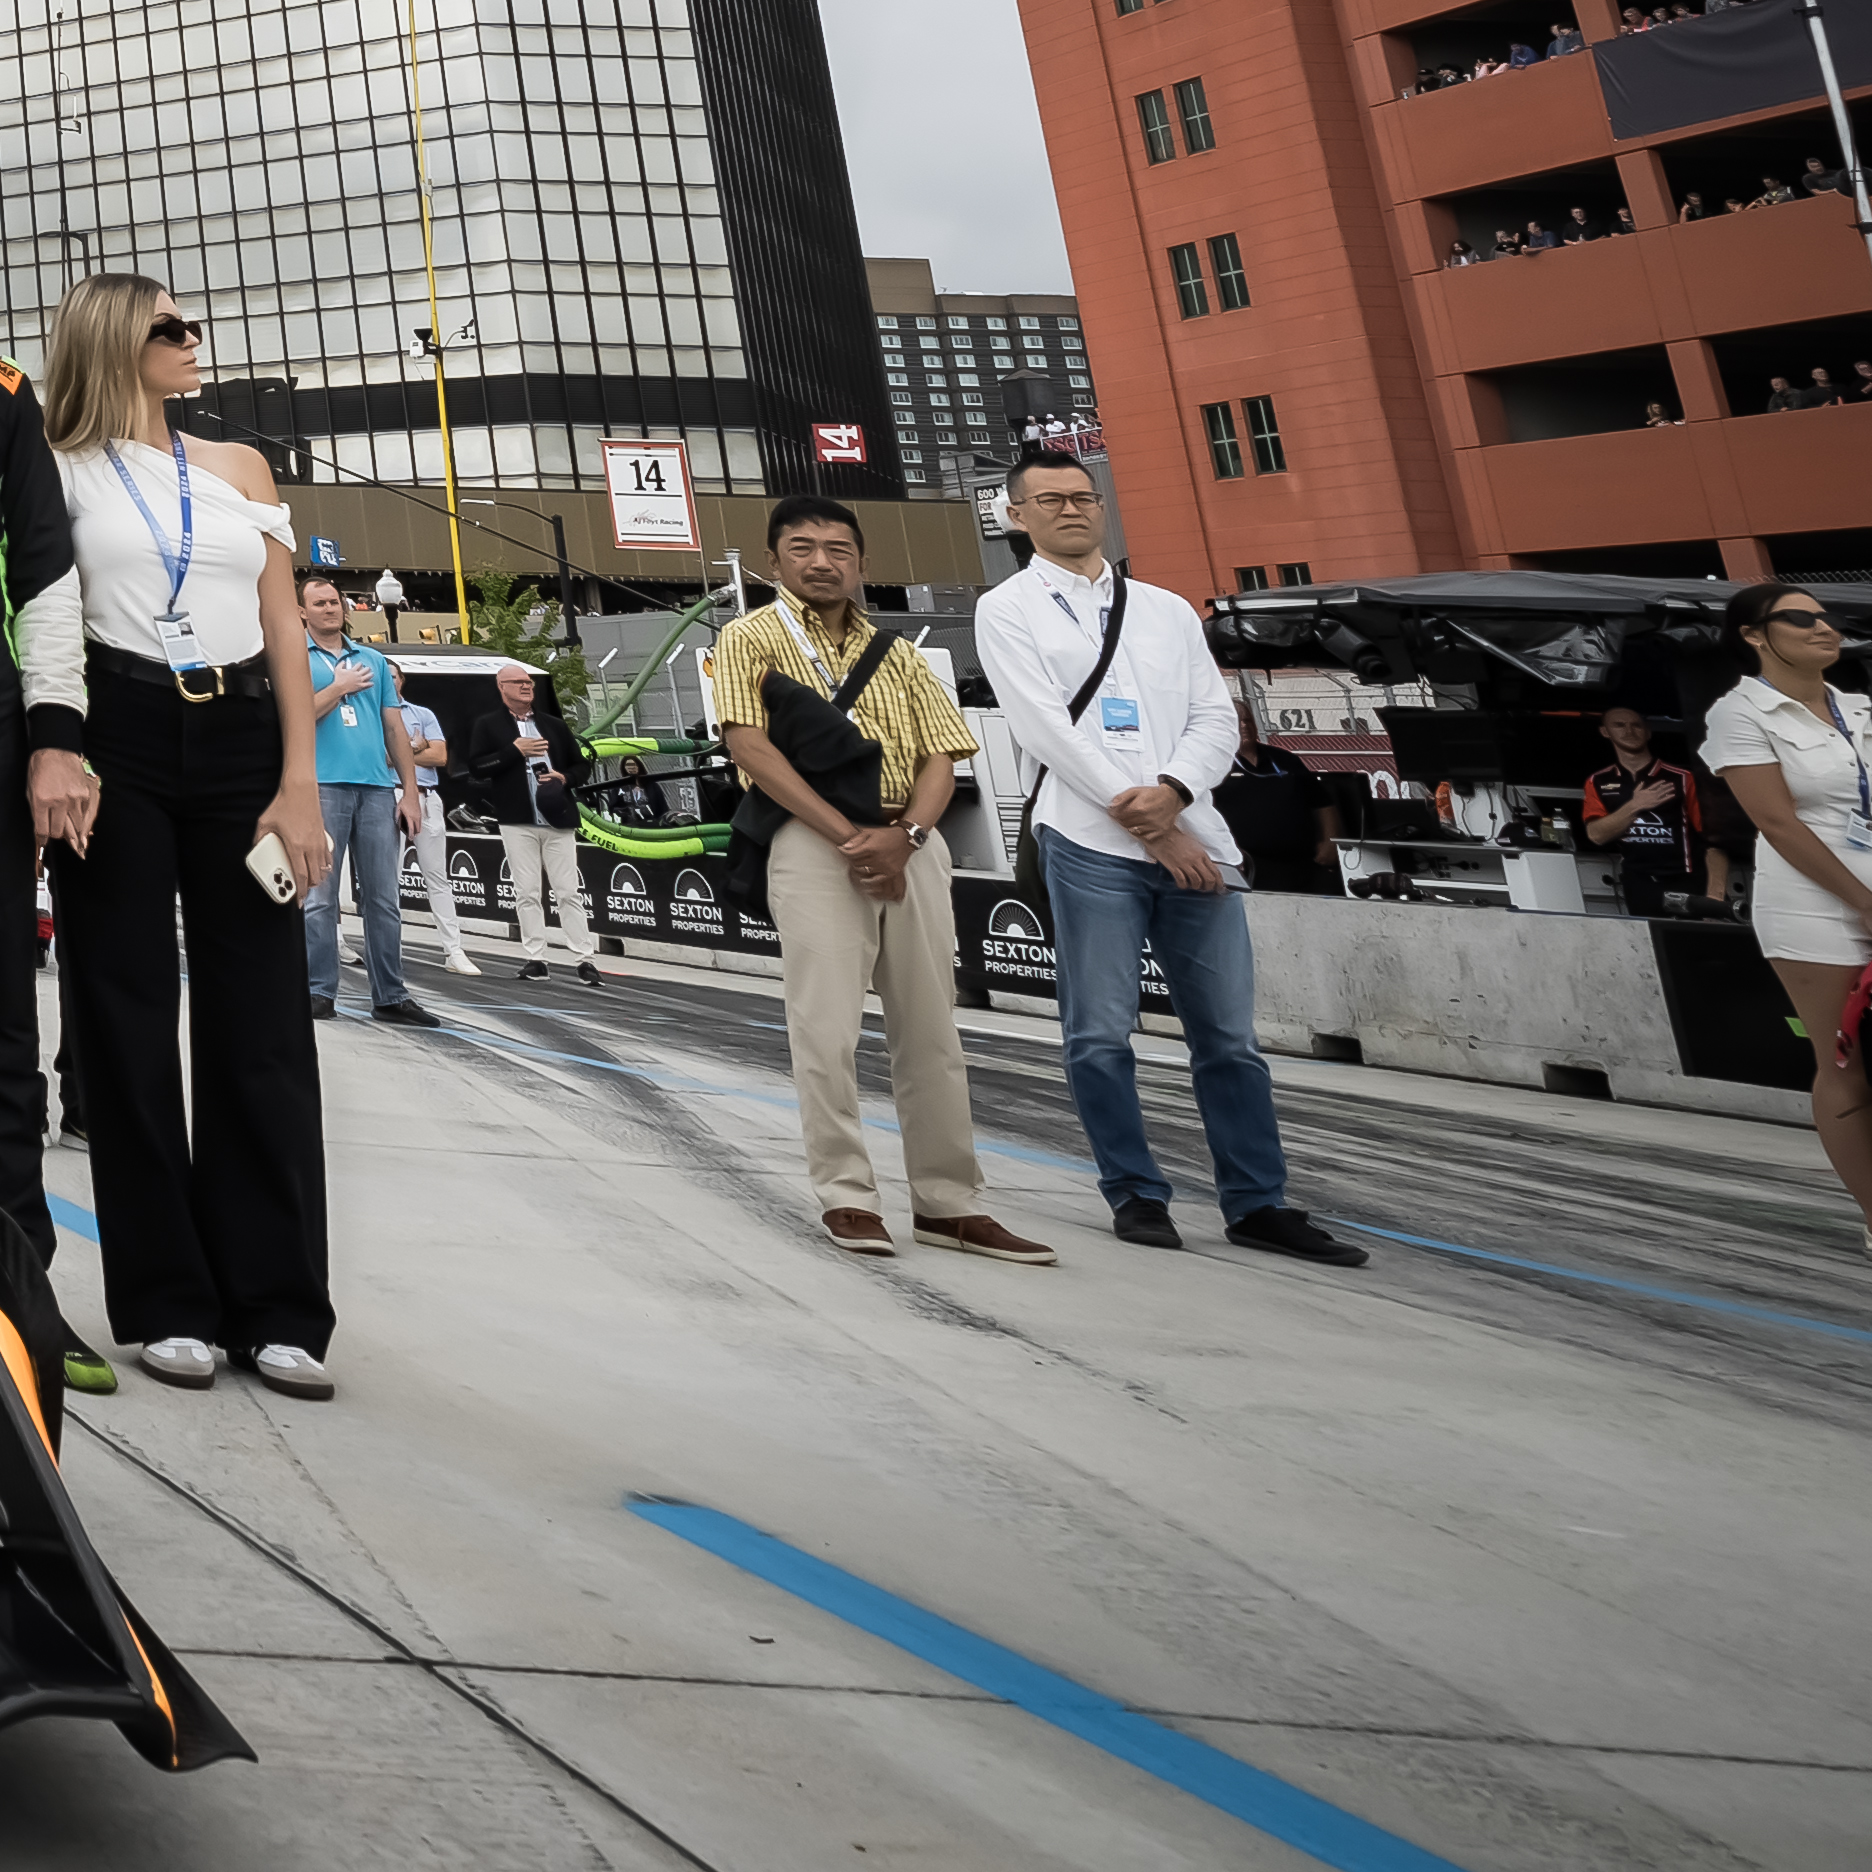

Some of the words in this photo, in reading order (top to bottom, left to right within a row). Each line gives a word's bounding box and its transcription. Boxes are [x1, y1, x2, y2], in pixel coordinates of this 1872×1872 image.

[818, 424, 862, 462] 14
[629, 459, 667, 492] 14
[977, 488, 995, 500] 600
[659, 518, 684, 527] Racing
[181, 531, 192, 560] 2024
[1279, 708, 1318, 731] 621
[1629, 826, 1673, 837] XTON
[591, 834, 619, 852] FUEL
[447, 880, 485, 895] SEXTON
[606, 896, 655, 914] SEXTON
[669, 903, 723, 922] SEXTON
[608, 911, 657, 927] PROPERTIES
[671, 919, 725, 935] PROPERTIES
[741, 927, 782, 943] PROPERT
[982, 939, 1057, 965] SEXTON
[985, 960, 1058, 982] PROPERTIES
